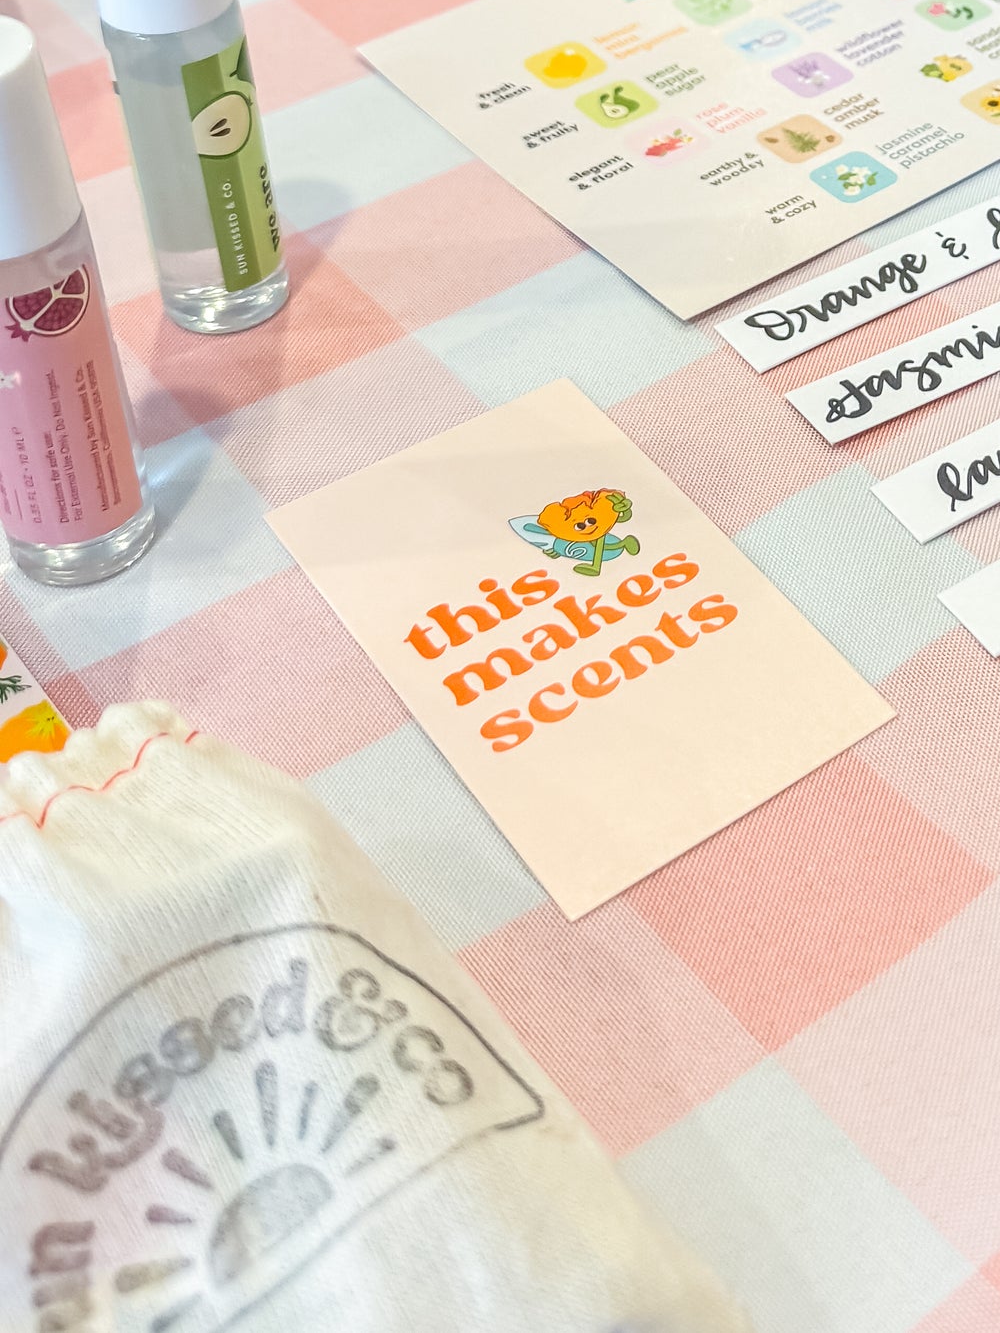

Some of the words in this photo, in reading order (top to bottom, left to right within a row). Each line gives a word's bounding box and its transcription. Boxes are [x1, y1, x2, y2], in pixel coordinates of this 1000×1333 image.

[835, 18, 904, 54] wildflower
[844, 29, 904, 61] lavender
[856, 43, 902, 67] cotton
[645, 63, 682, 84] pear
[654, 66, 699, 91] apple
[476, 80, 517, 100] fresh
[493, 85, 532, 106] clean
[663, 74, 708, 98] sugar
[695, 102, 730, 121] rose
[823, 93, 865, 116] cedar
[833, 97, 881, 124] amber
[706, 106, 745, 130] plum
[716, 107, 768, 135] vanilla
[844, 109, 885, 131] musk
[522, 119, 565, 142] sweet
[540, 123, 579, 145] fruity
[875, 121, 934, 156] jasmine
[888, 126, 948, 161] caramel
[900, 131, 965, 170] pistachio
[568, 154, 625, 184] elegant
[593, 161, 634, 185] floral
[700, 157, 746, 182] earthy
[709, 158, 766, 188] woodsy
[222, 178, 233, 198] CO.
[225, 200, 236, 210] &
[764, 193, 805, 216] warm
[770, 215, 785, 225] &
[785, 199, 818, 219] cozy
[228, 213, 244, 252] KISSED
[934, 231, 970, 260] &
[236, 253, 248, 275] SUN
[55, 418, 66, 432] Do
[85, 422, 96, 439] Sun
[46, 449, 58, 468] safe
[63, 454, 74, 471] Use
[50, 469, 61, 482] for
[52, 480, 70, 524] Directions
[67, 472, 82, 509] External
[403, 568, 561, 660] this
[442, 552, 700, 707] makes
[479, 593, 739, 753] scents
